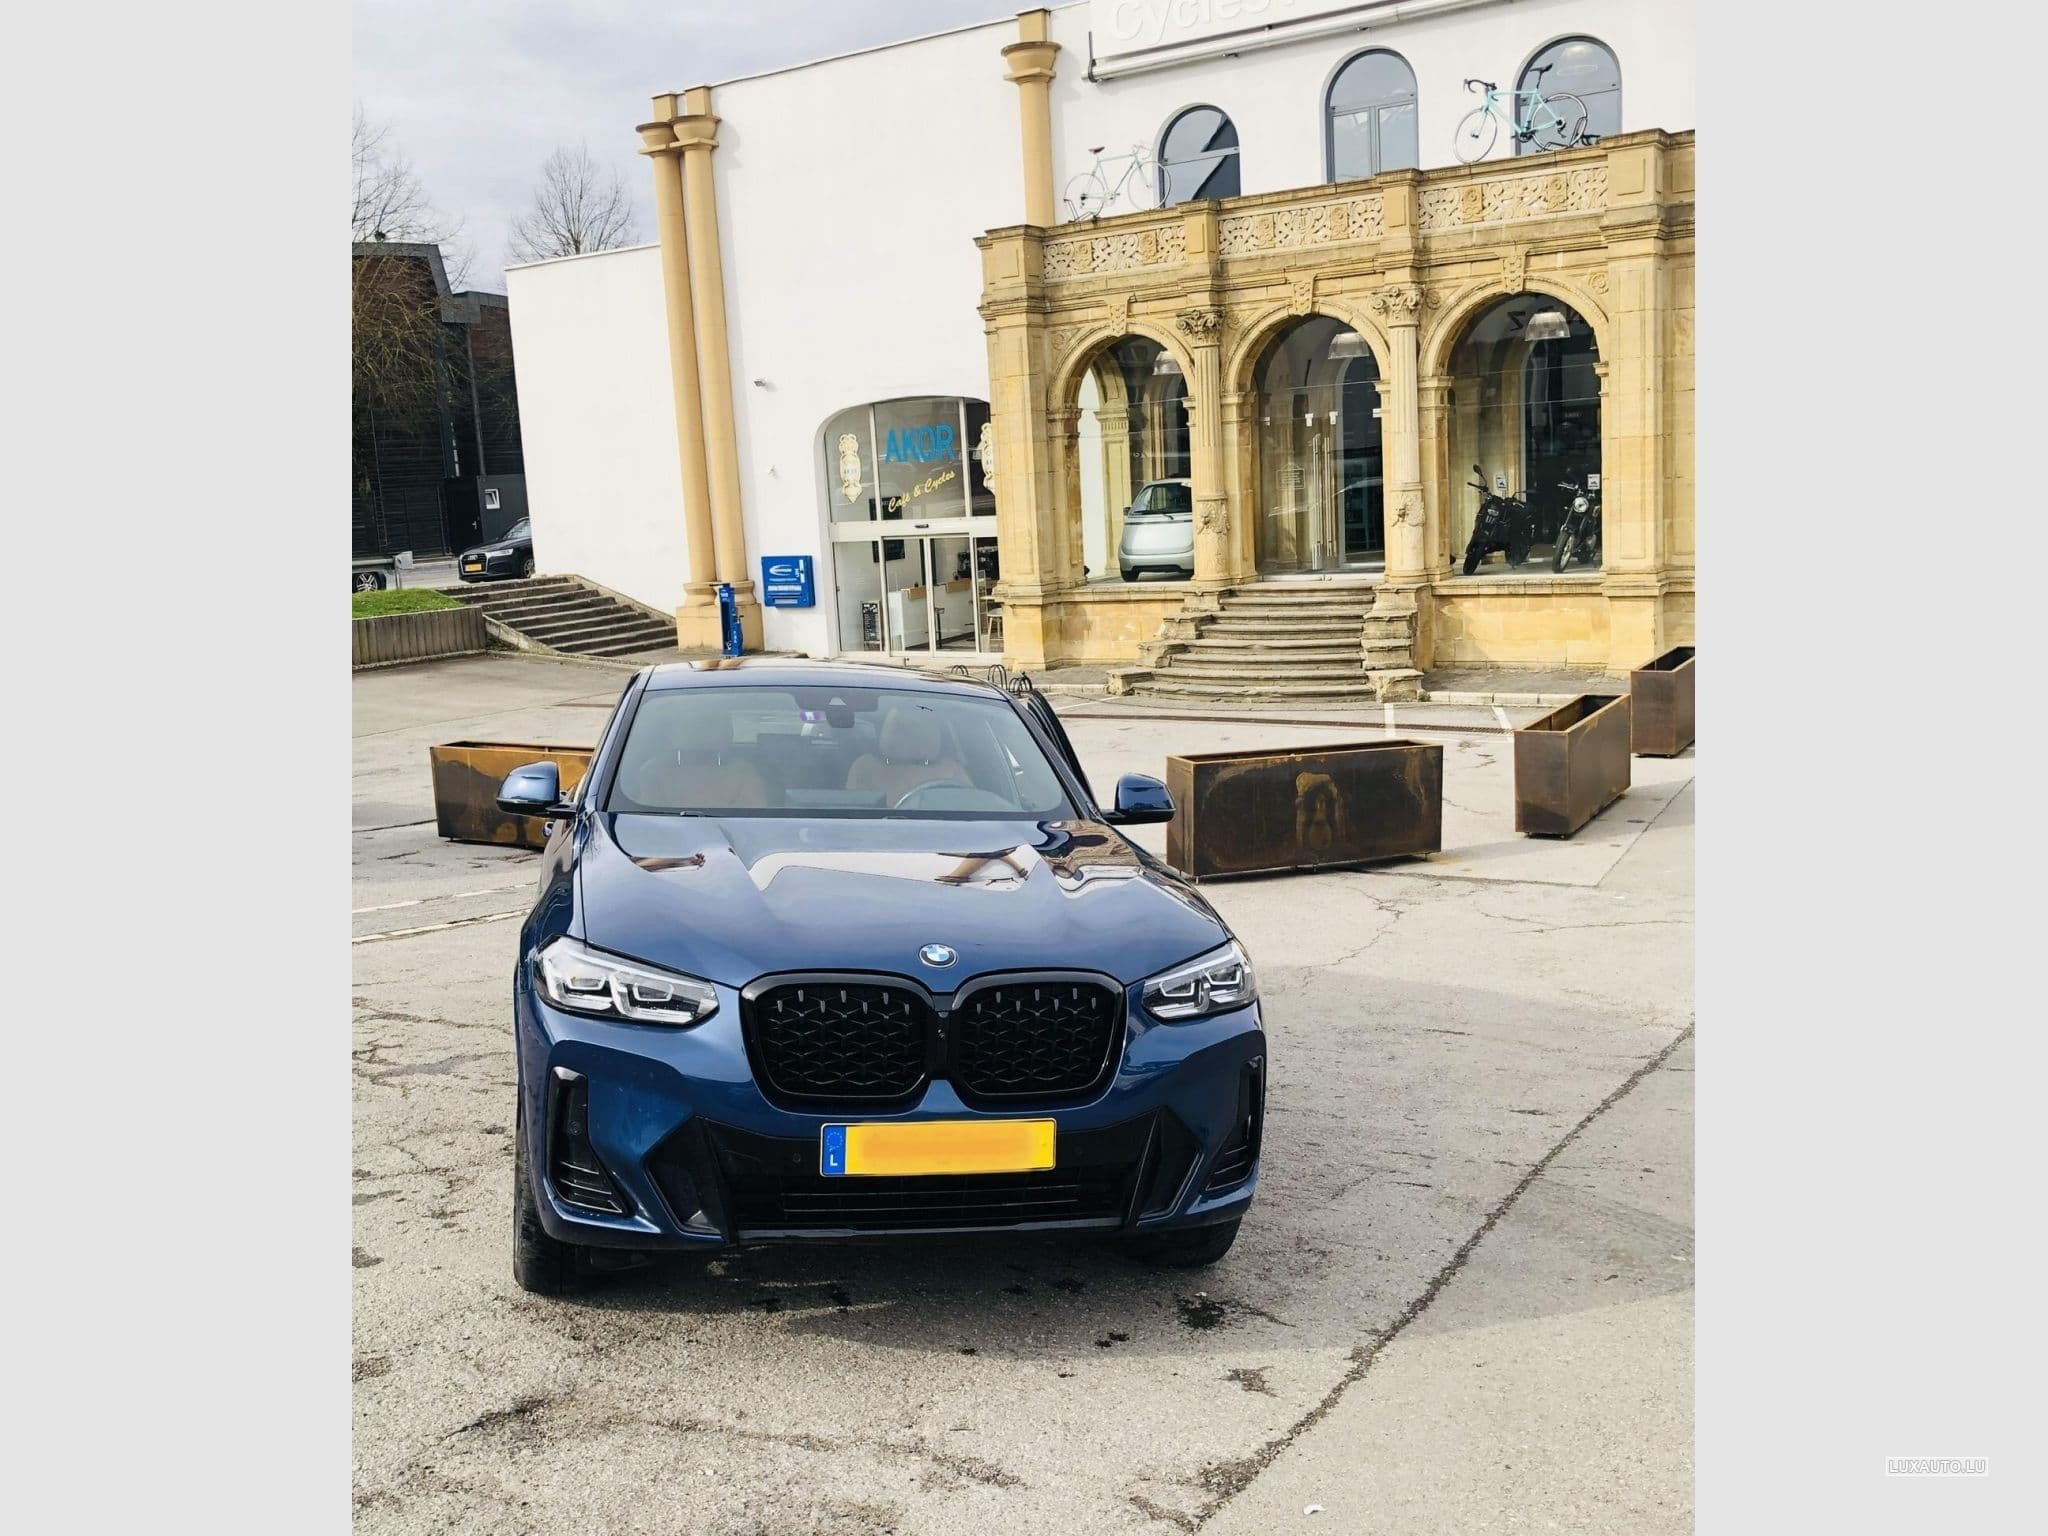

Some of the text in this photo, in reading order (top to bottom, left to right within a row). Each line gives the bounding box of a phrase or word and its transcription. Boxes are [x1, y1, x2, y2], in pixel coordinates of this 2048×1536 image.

[884, 424, 956, 464] AKOR
[913, 484, 921, 497] &
[924, 470, 955, 493] Cycles
[830, 1154, 838, 1167] L
